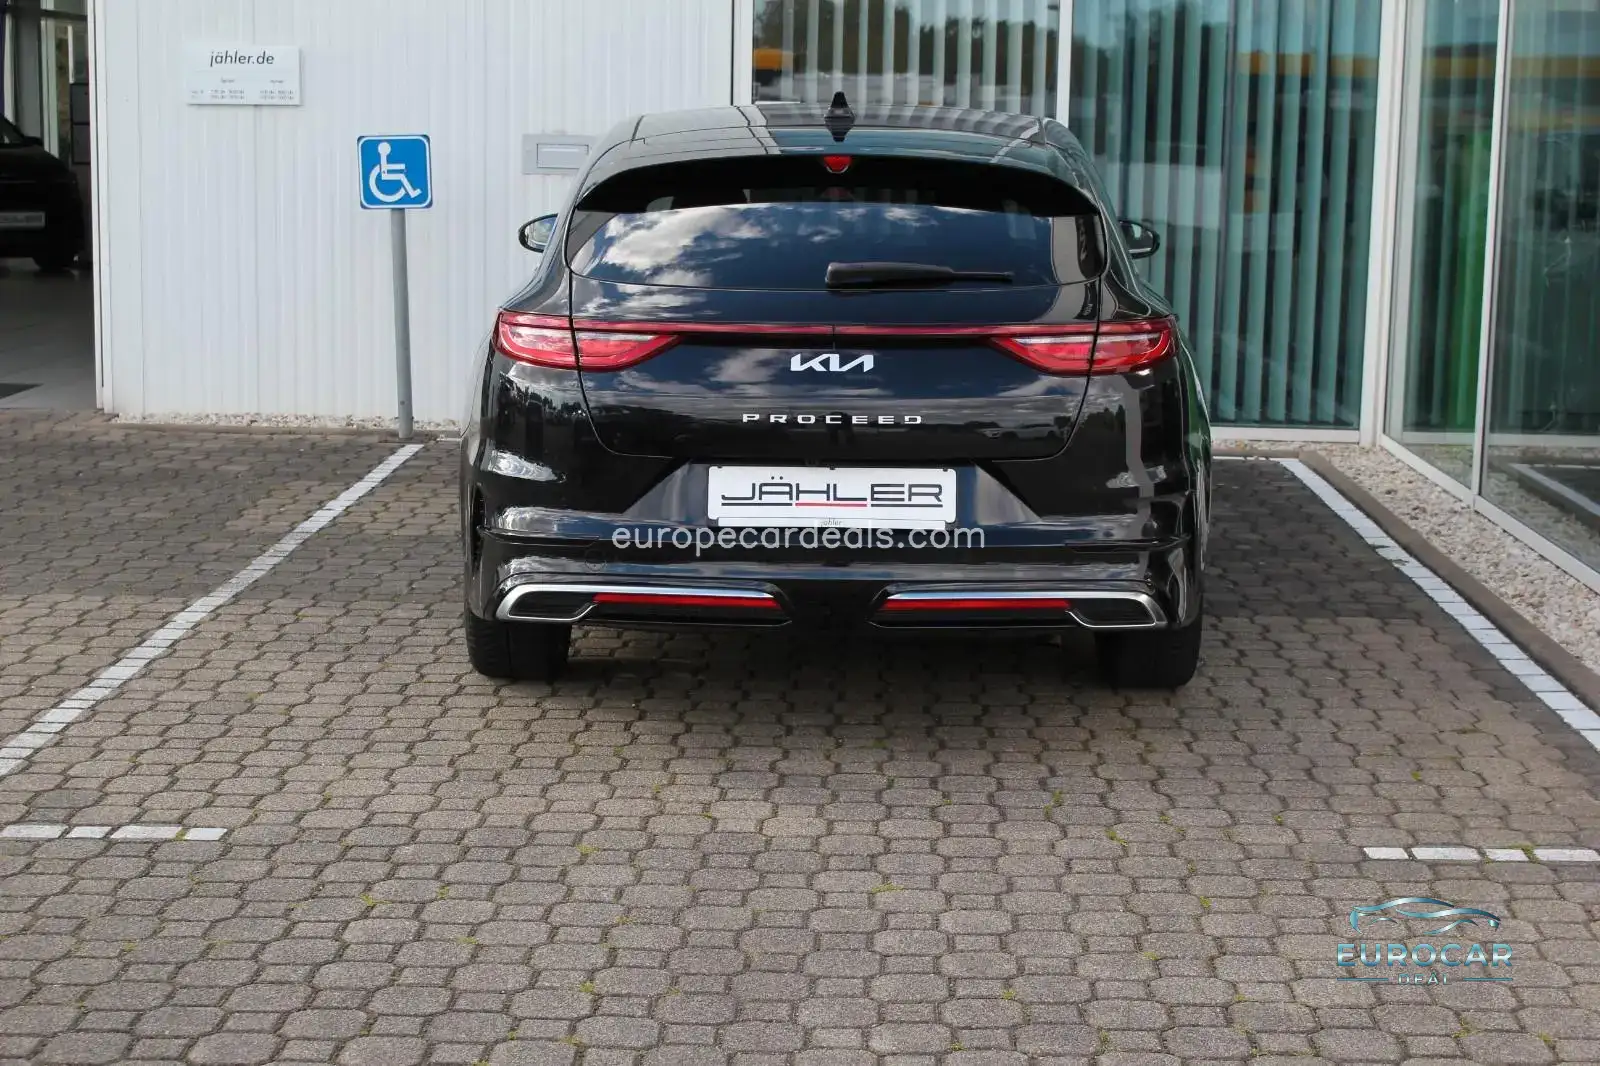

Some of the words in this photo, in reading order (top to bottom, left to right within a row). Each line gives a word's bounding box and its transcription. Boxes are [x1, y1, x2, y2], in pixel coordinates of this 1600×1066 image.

[209, 49, 275, 68] jähler.de
[791, 353, 873, 373] KIA
[743, 413, 922, 425] PROCEED
[721, 475, 944, 503] JÄHLER
